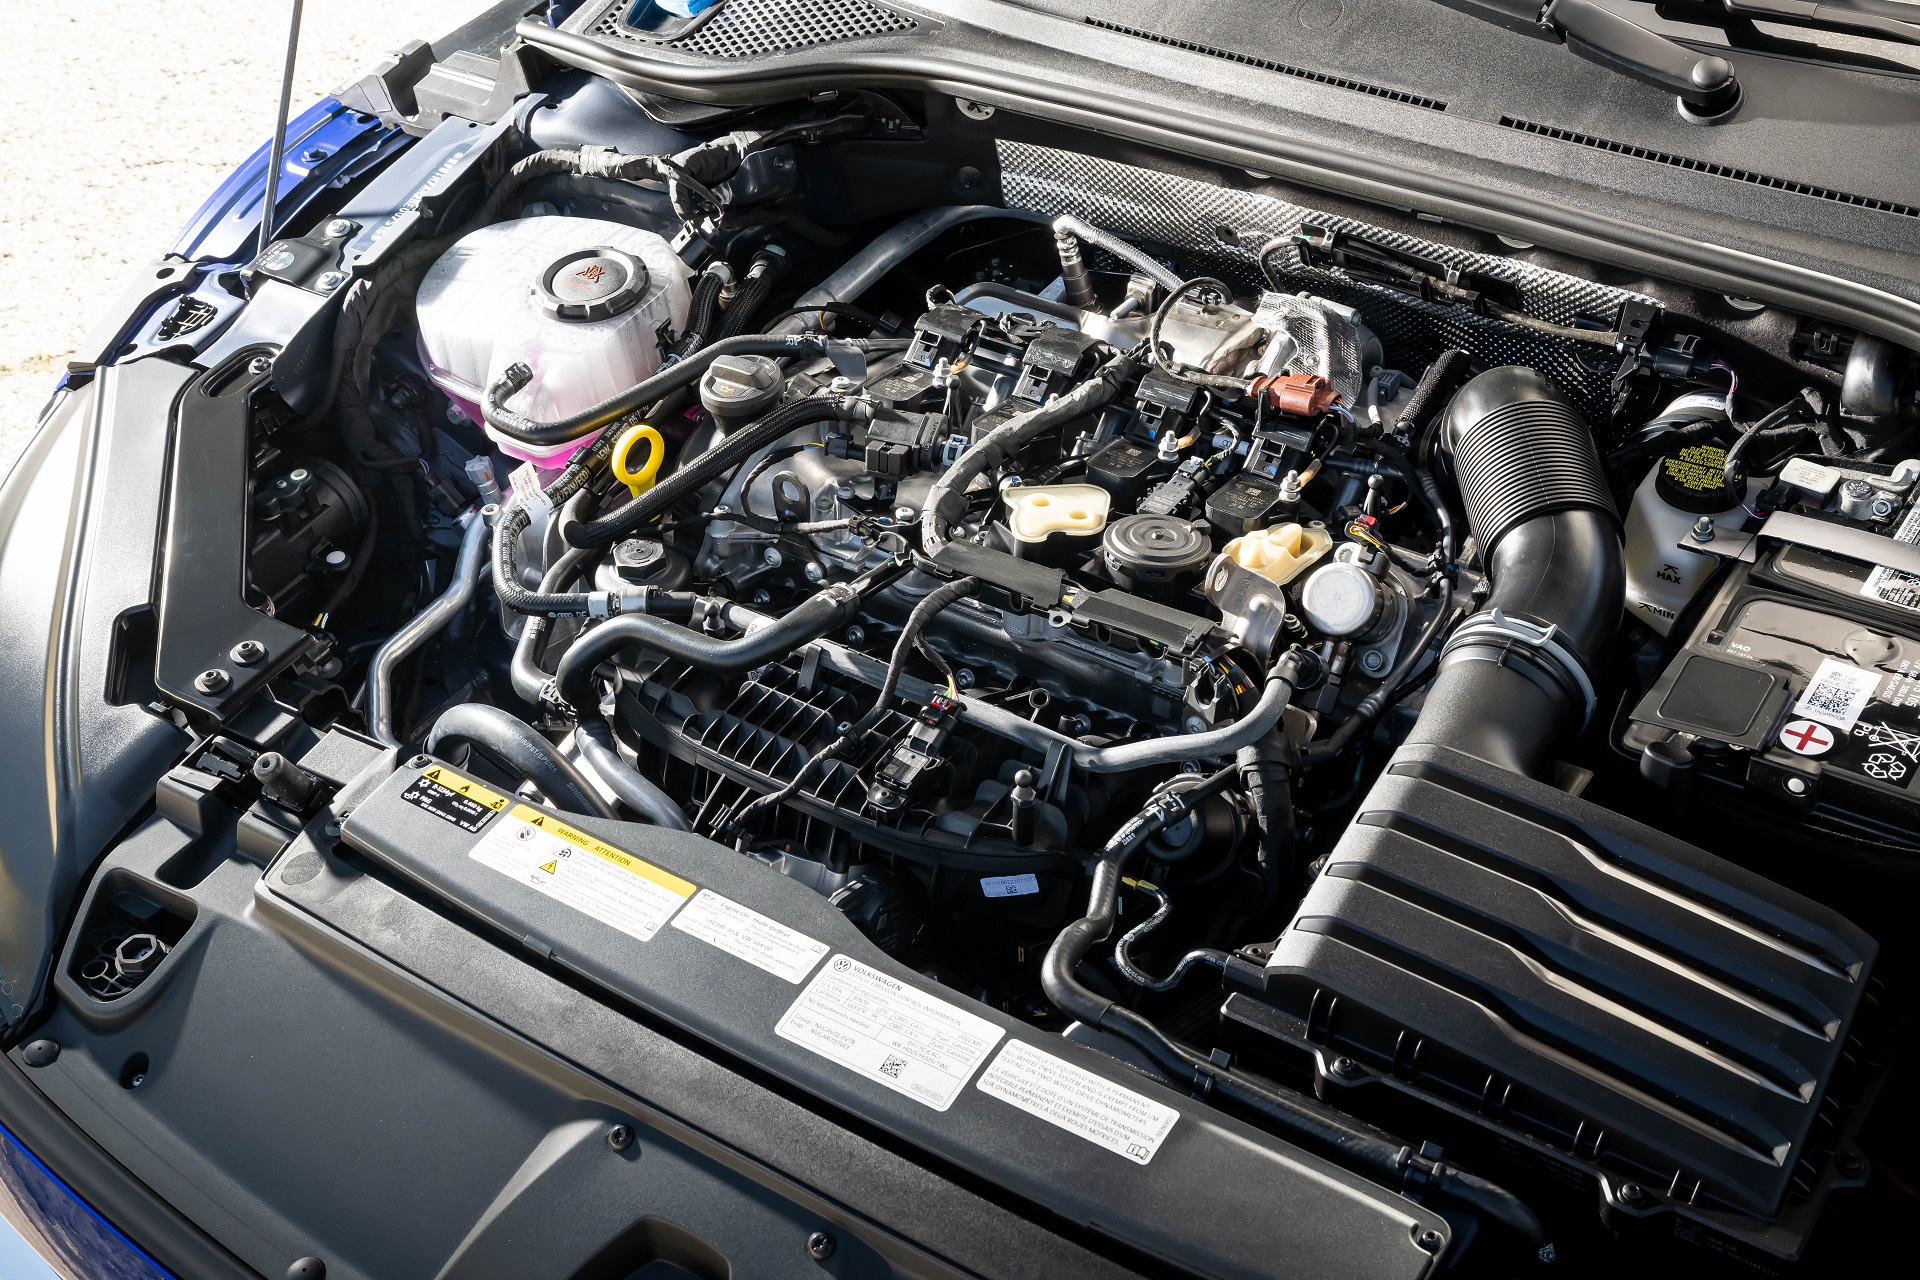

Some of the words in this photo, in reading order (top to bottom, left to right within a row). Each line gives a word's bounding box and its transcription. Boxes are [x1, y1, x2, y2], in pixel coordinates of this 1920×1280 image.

[1656, 570, 1681, 584] MAX
[1653, 606, 1674, 619] MIN
[1854, 725, 1872, 736] Pb
[420, 795, 432, 804] PAG
[459, 820, 470, 829] VW
[556, 827, 589, 845] WARNING
[594, 845, 631, 865] ATTENTION
[719, 902, 740, 914] Engine
[752, 917, 769, 927] Huile
[768, 925, 790, 937] moteur
[853, 966, 902, 990] VOLKSWAGEN
[815, 1001, 849, 1020] adjustments
[827, 974, 853, 988] Conforms
[859, 988, 890, 1005] regulations
[958, 1034, 972, 1042] 2022
[848, 971, 870, 983] VEHICLE
[870, 981, 897, 996] EMISSION
[897, 993, 922, 1007] CONTROL
[923, 1005, 962, 1025] INFORMATION
[946, 1048, 970, 1062] Gasoline
[952, 1041, 976, 1055] Gasoline
[999, 1055, 1025, 1070] TESTING
[1025, 1067, 1036, 1075] ON
[1075, 1089, 1095, 1101] DRIVE
[1008, 1043, 1023, 1053] THIS
[1023, 1050, 1048, 1064] VEHICLE
[1056, 1064, 1087, 1081] EQUIPPED
[1087, 1078, 1105, 1089] WITH
[1111, 1089, 1150, 1109] PERMANENT
[1038, 1064, 1057, 1076] DRIVE
[1057, 1073, 1081, 1086] SYSTEM
[1080, 1083, 1097, 1094] AND
[1103, 1093, 1127, 1107] EXEMPT
[1127, 1104, 1147, 1116] FROM
[982, 1078, 995, 1087] SUR
[1049, 1109, 1067, 1120] DEUX
[1066, 1117, 1088, 1130] ROUES
[1018, 1086, 1054, 1105] PERMANENT
[1087, 1118, 1113, 1133] D'ESSAIS
[1028, 1082, 1041, 1091] EST
[1056, 1095, 1074, 1106] D'UN
[1099, 1114, 1110, 1122] DE
[1109, 1119, 1155, 1143] TRANSMISSION
